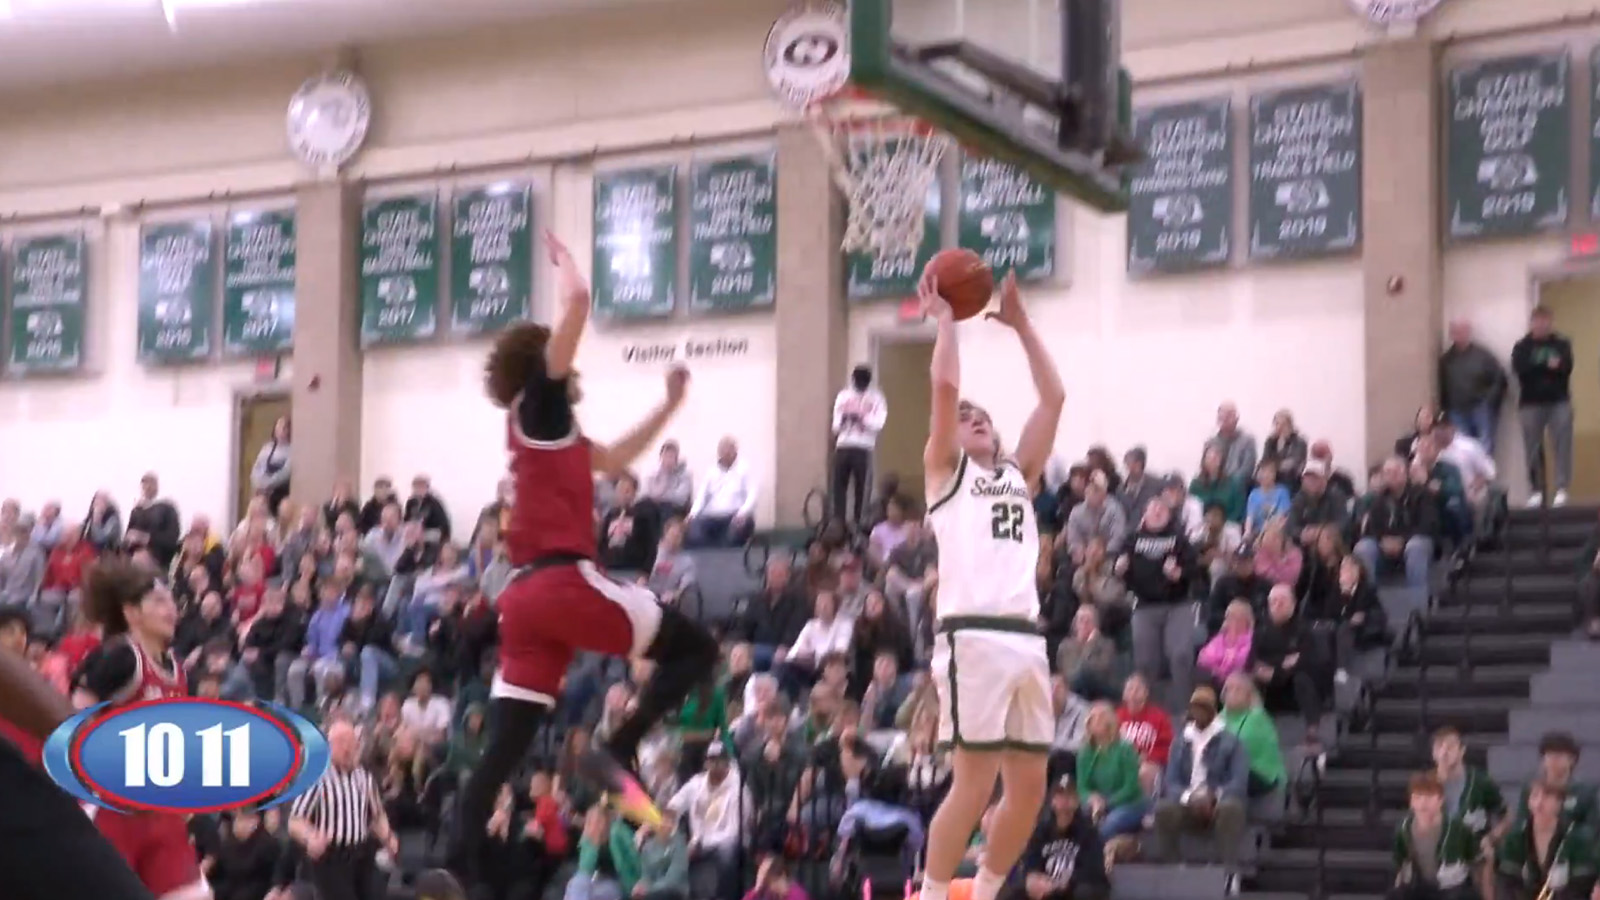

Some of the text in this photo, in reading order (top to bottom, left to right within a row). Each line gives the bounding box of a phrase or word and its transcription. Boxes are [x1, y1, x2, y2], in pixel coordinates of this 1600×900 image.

[621, 337, 749, 363] Visitor Section
[991, 502, 1024, 543] 22
